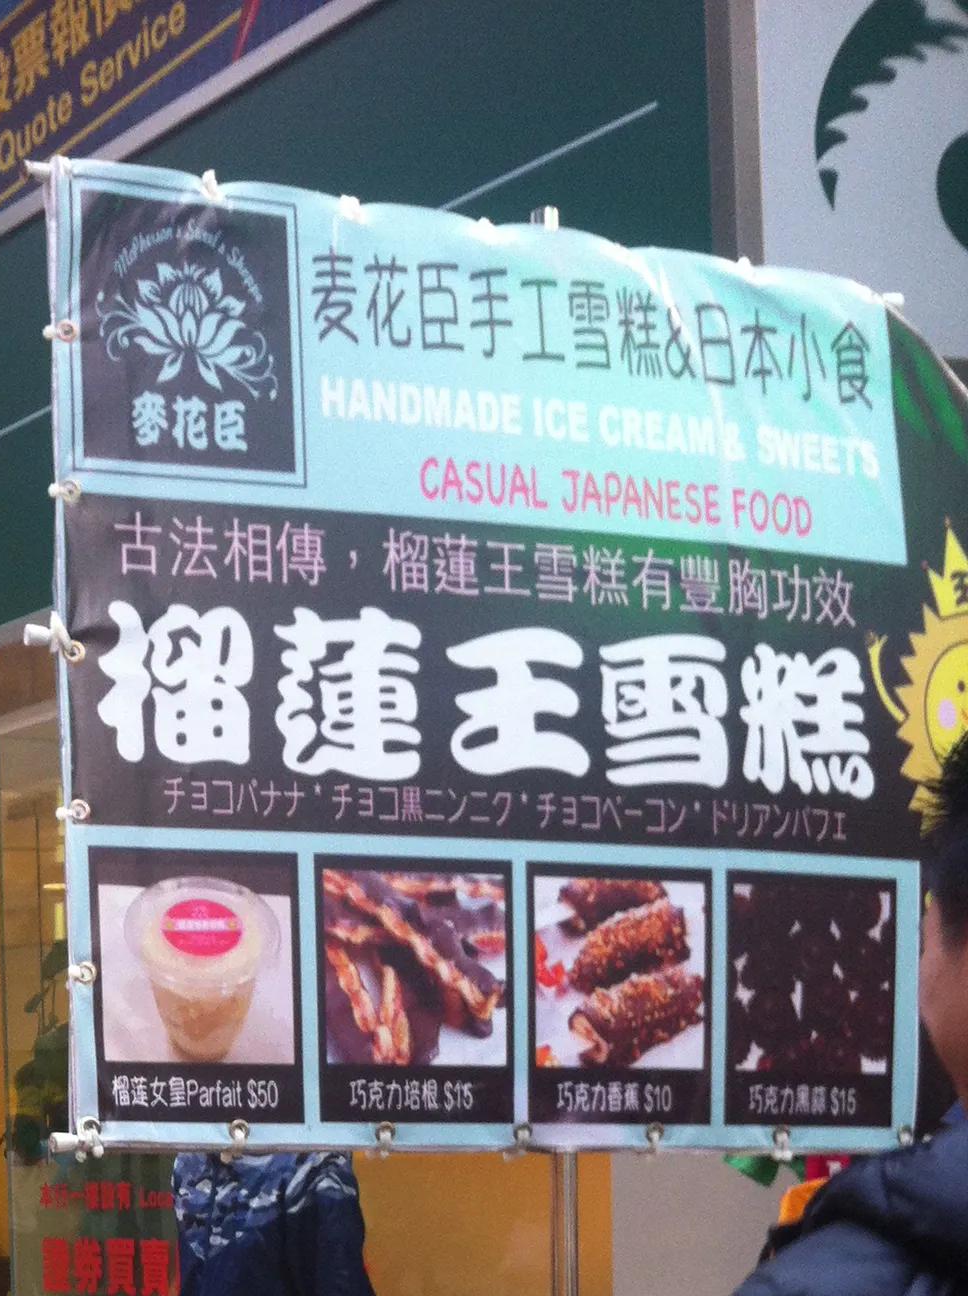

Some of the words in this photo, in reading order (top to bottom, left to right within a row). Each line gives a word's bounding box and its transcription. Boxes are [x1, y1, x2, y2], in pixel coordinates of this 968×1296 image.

[80, 1, 187, 107] Service
[319, 374, 522, 436] HANDMADE
[533, 397, 589, 443] ICE
[598, 403, 714, 459] CREAM
[756, 423, 880, 480] SWEETS
[419, 455, 548, 509] CASUAL
[561, 468, 722, 526] JAPANESE
[732, 486, 812, 537] FOOD
[97, 600, 875, 800] 榴蓮王雪糕
[247, 1079, 279, 1109] $50
[443, 1080, 474, 1111] $15
[644, 1083, 672, 1113] $10
